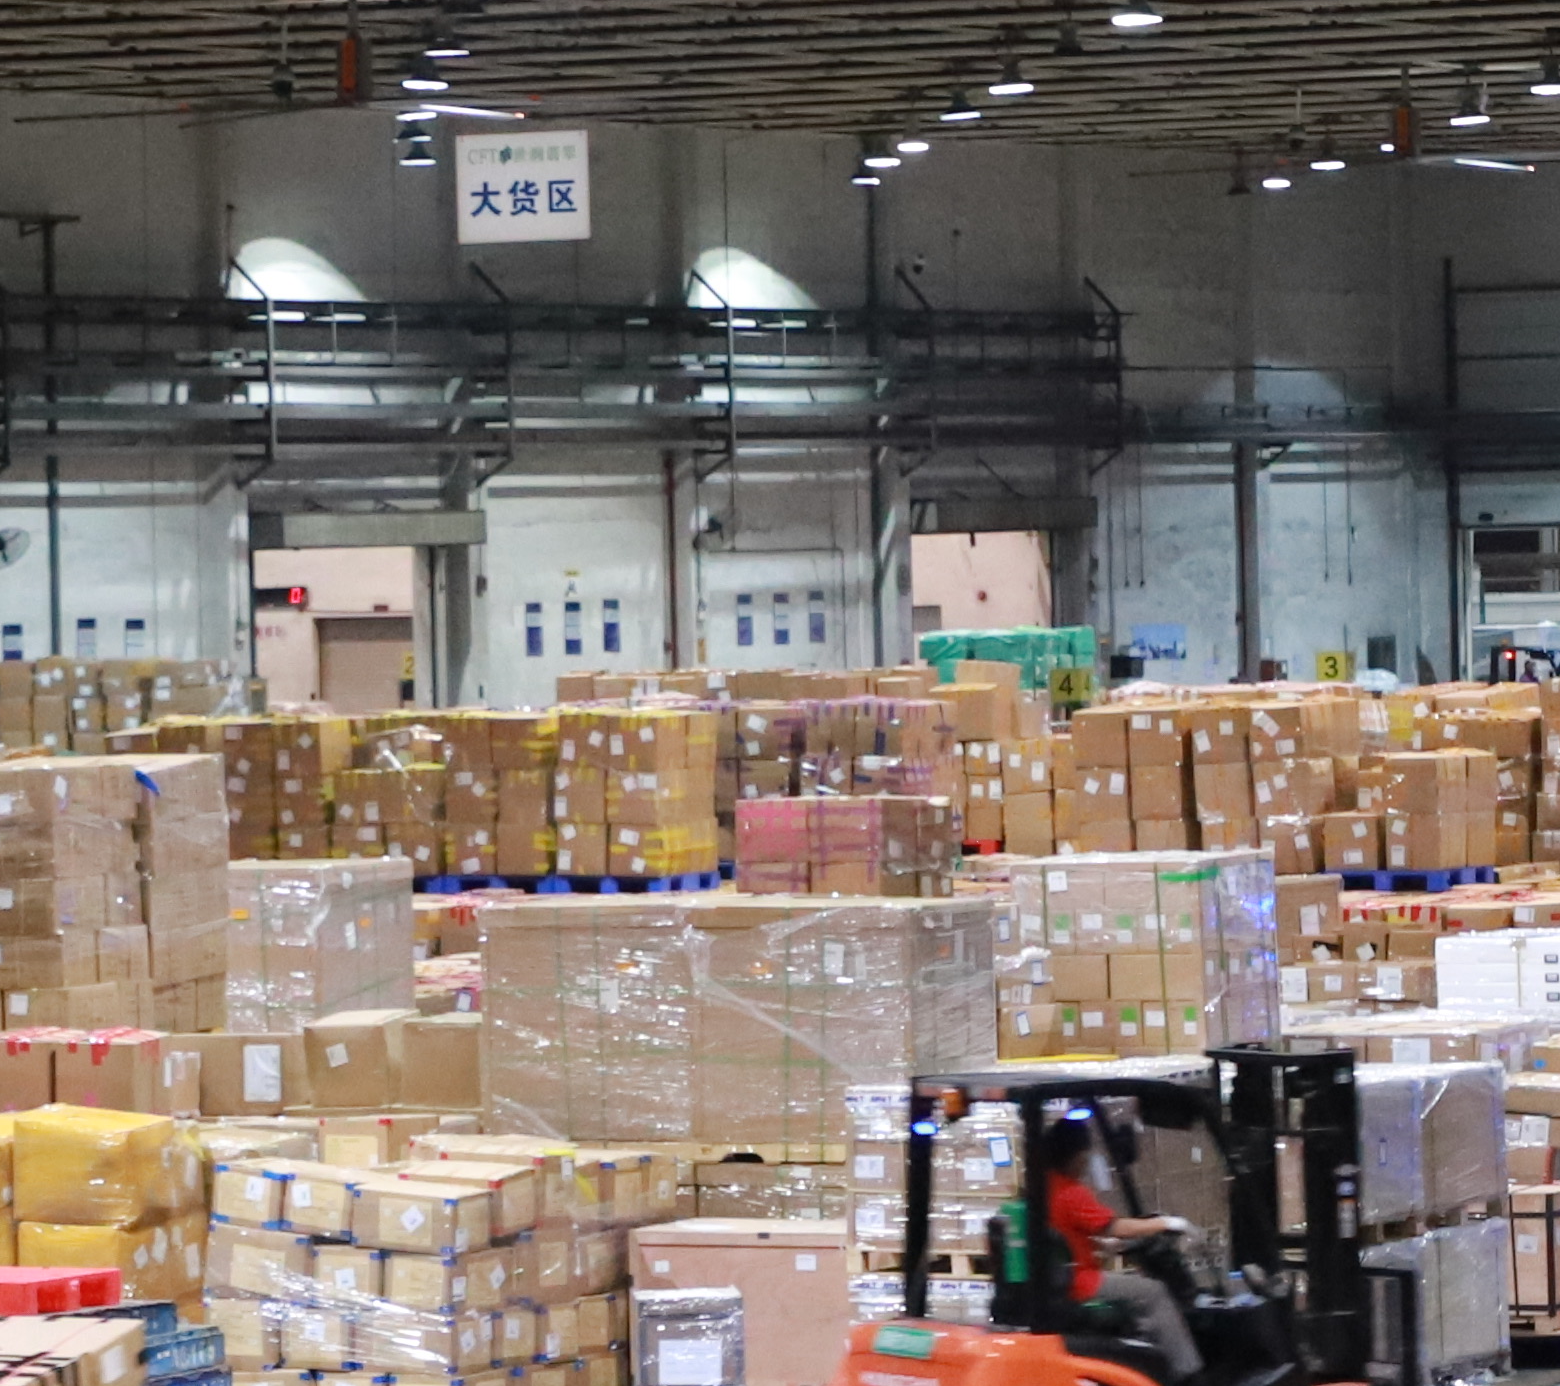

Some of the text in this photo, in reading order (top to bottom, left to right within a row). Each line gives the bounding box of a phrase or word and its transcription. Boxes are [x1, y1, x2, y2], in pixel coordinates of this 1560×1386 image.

[469, 179, 578, 218] 大货区
[1323, 656, 1340, 679] 3
[1058, 674, 1074, 696] 4
